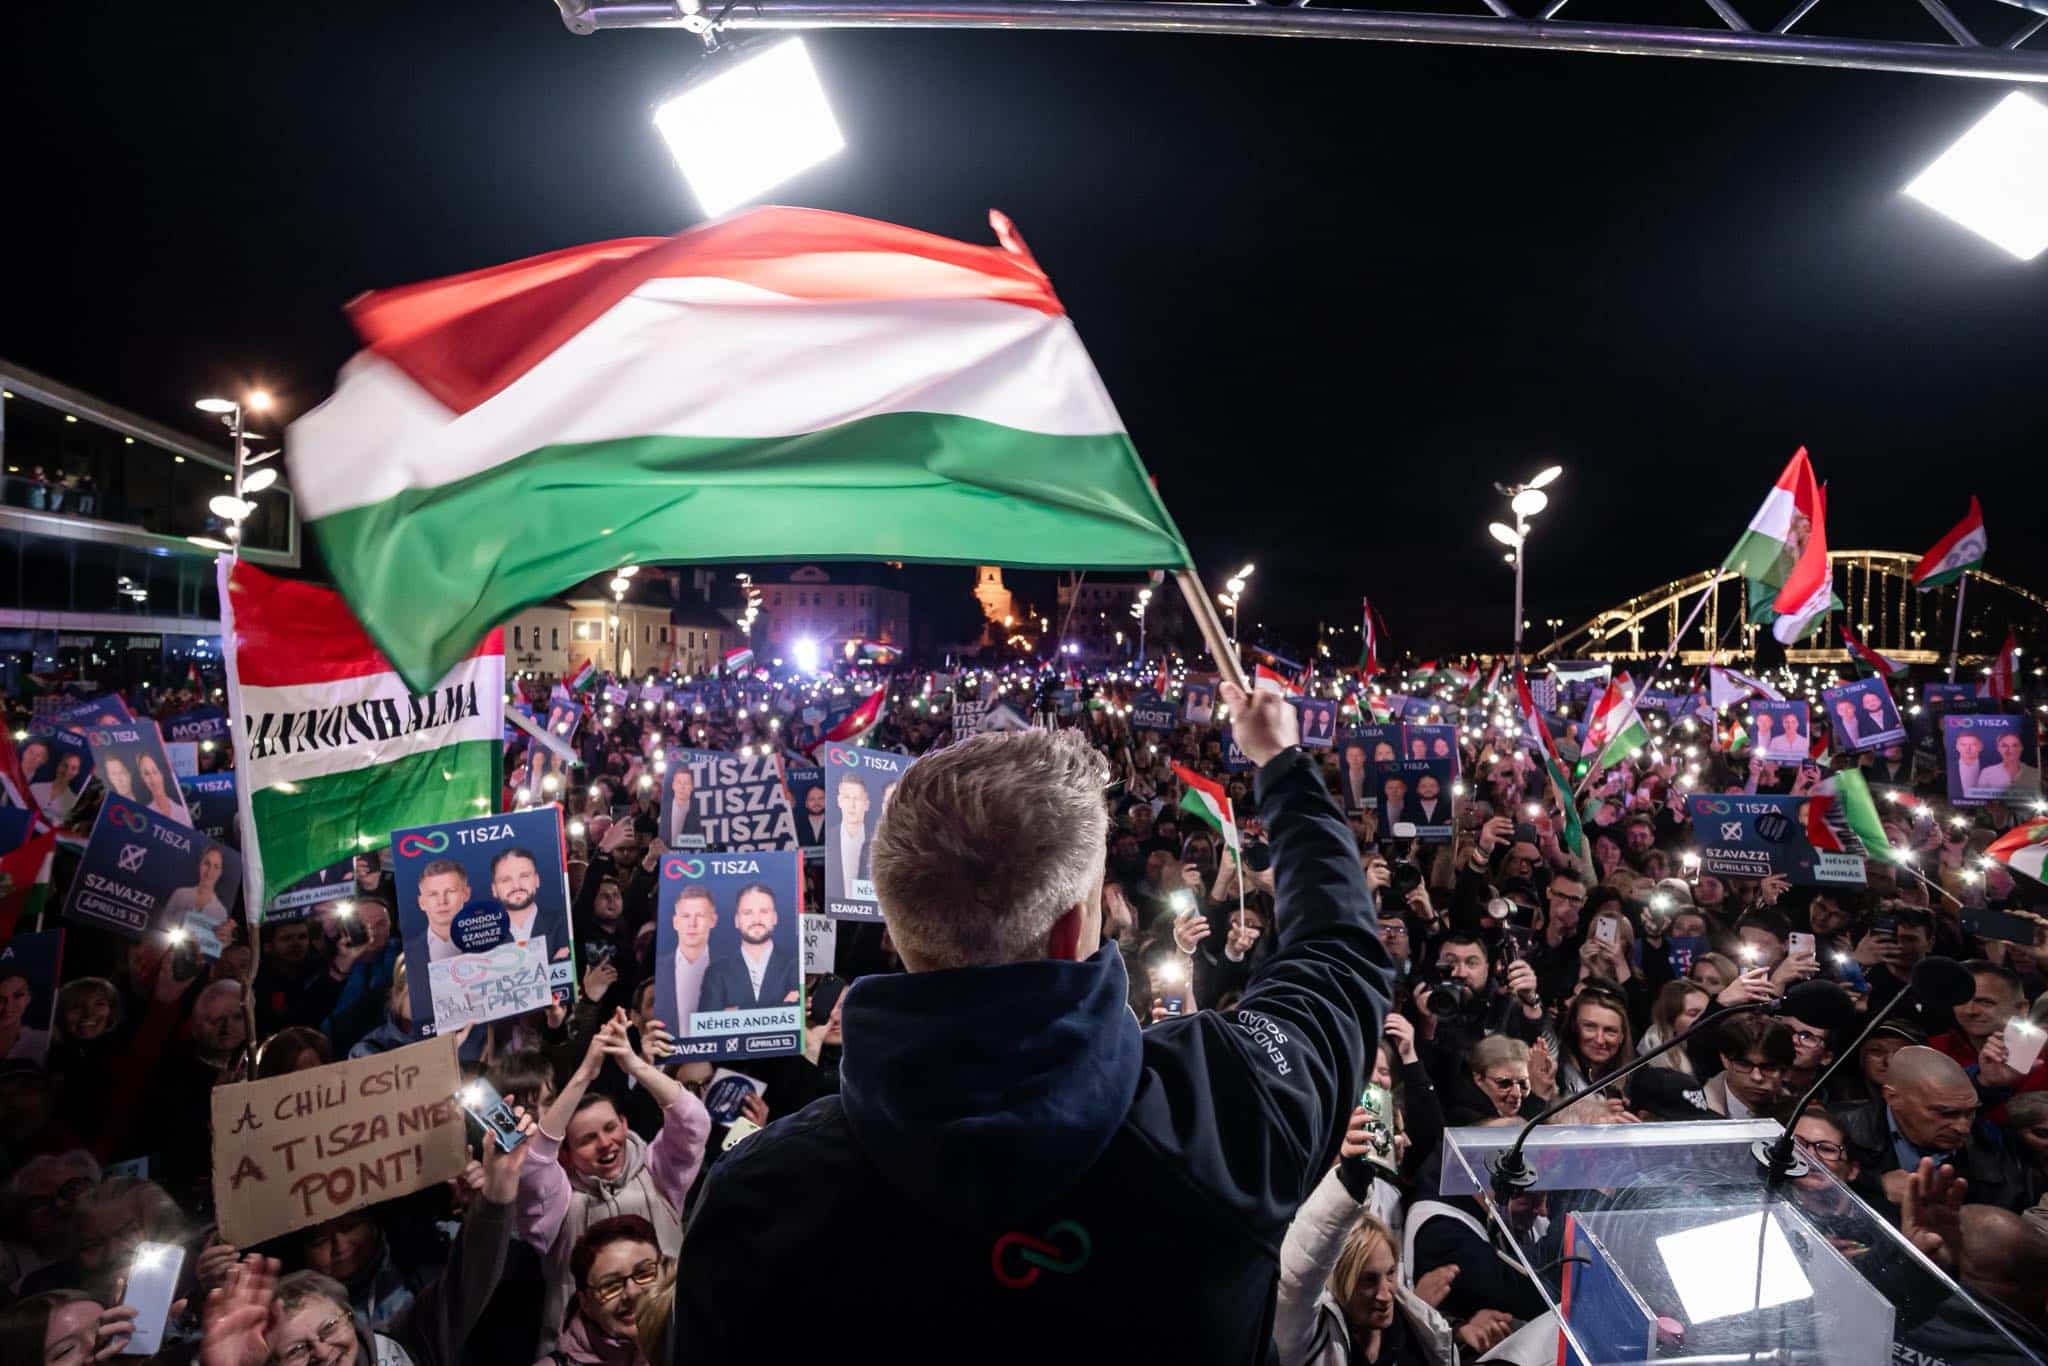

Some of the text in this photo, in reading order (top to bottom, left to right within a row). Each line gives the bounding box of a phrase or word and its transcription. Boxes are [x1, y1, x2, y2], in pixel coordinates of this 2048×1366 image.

[1133, 710, 1172, 723] MOST
[1977, 719, 2009, 727] TISZA
[688, 753, 782, 788] TISZA
[863, 756, 898, 772] TISZA
[196, 780, 232, 793] TISZA
[694, 783, 787, 817] TISZA
[1736, 803, 1782, 815] TISZA
[456, 823, 515, 846] TISZA
[700, 810, 797, 844] TISZA
[152, 824, 191, 855] TISZA
[1705, 848, 1770, 861] SZAVAZZ!
[712, 860, 760, 875] TISZA
[831, 903, 873, 915] SZAVAZZ!
[697, 1011, 796, 1031] NÉHER ANDRÁS
[1238, 1010, 1289, 1044] SQUAD
[672, 1042, 718, 1056] AVAZZ!
[231, 1104, 263, 1134] A
[230, 1156, 266, 1190] A
[272, 1115, 390, 1172] TISZA
[289, 1145, 424, 1217] PONT!
